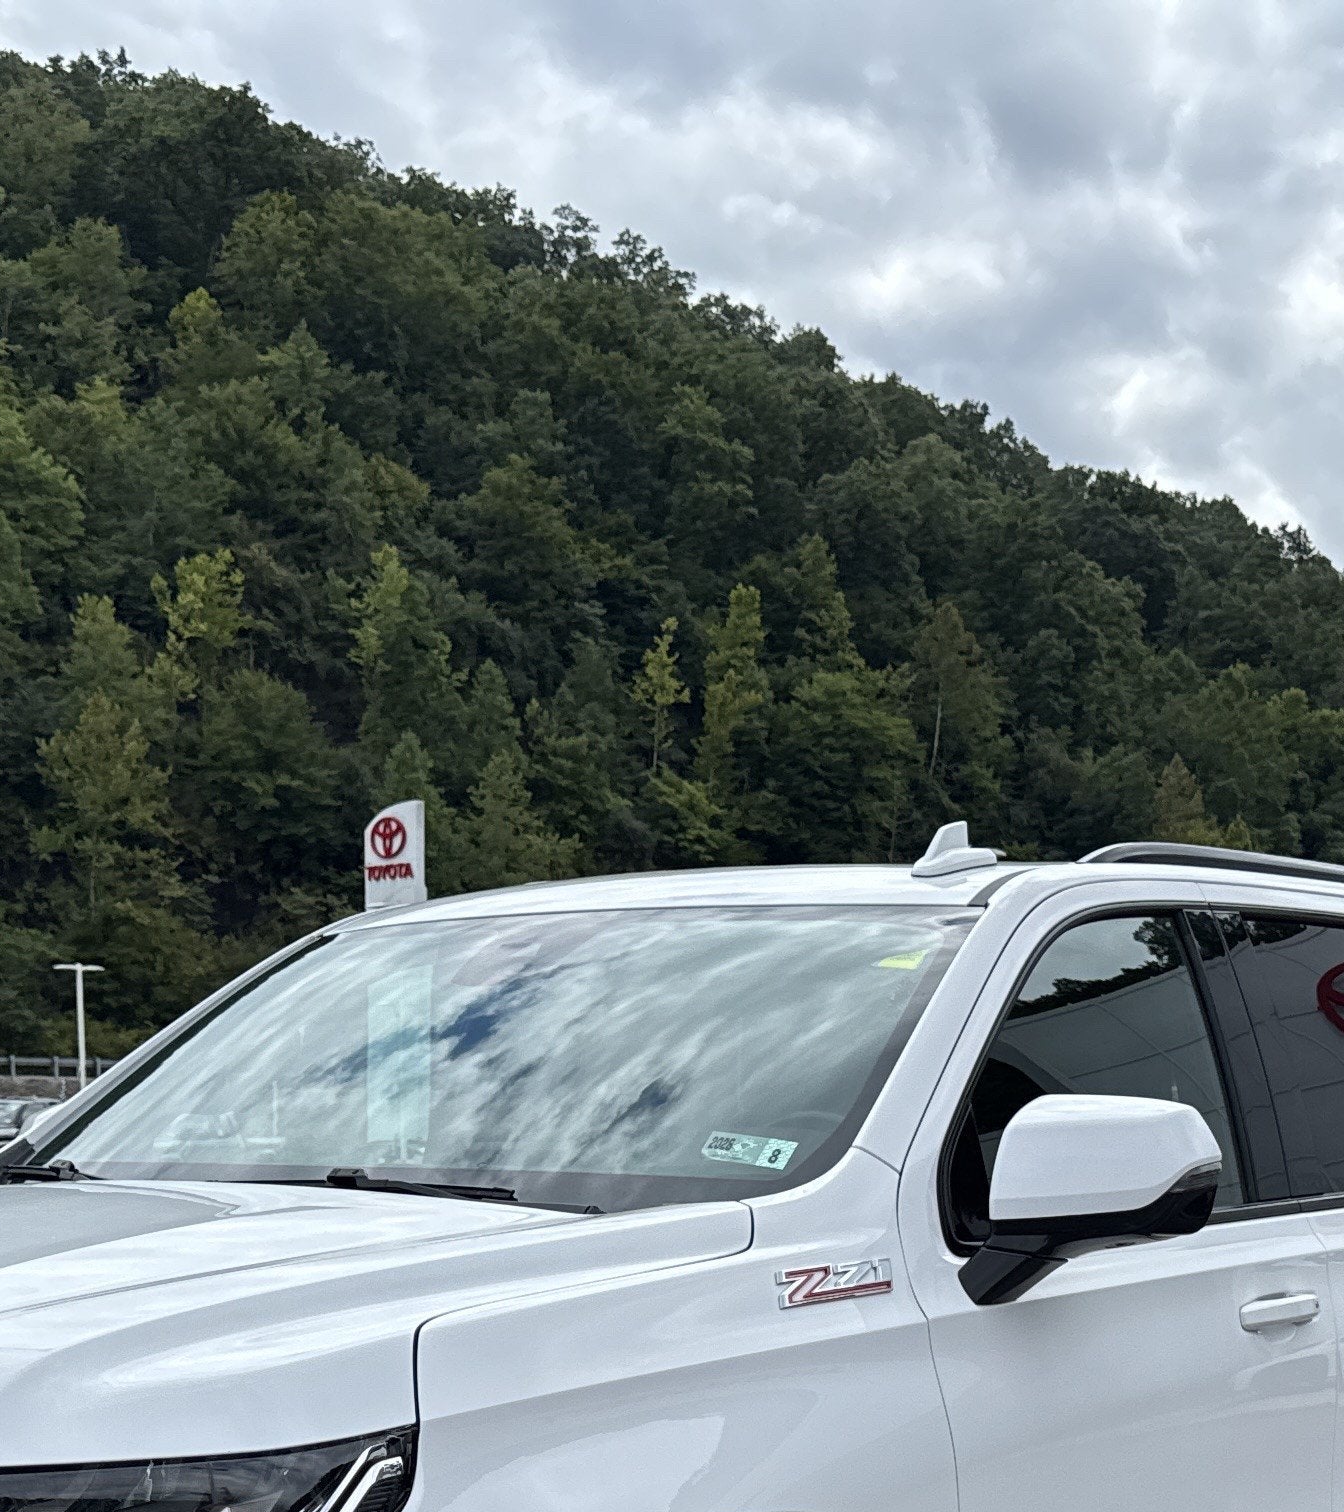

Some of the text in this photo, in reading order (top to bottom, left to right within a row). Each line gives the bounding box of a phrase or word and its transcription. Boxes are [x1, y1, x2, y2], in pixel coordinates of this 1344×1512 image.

[367, 863, 414, 881] TOYOTA
[768, 1149, 782, 1164] 8
[775, 1258, 894, 1310] Z71
